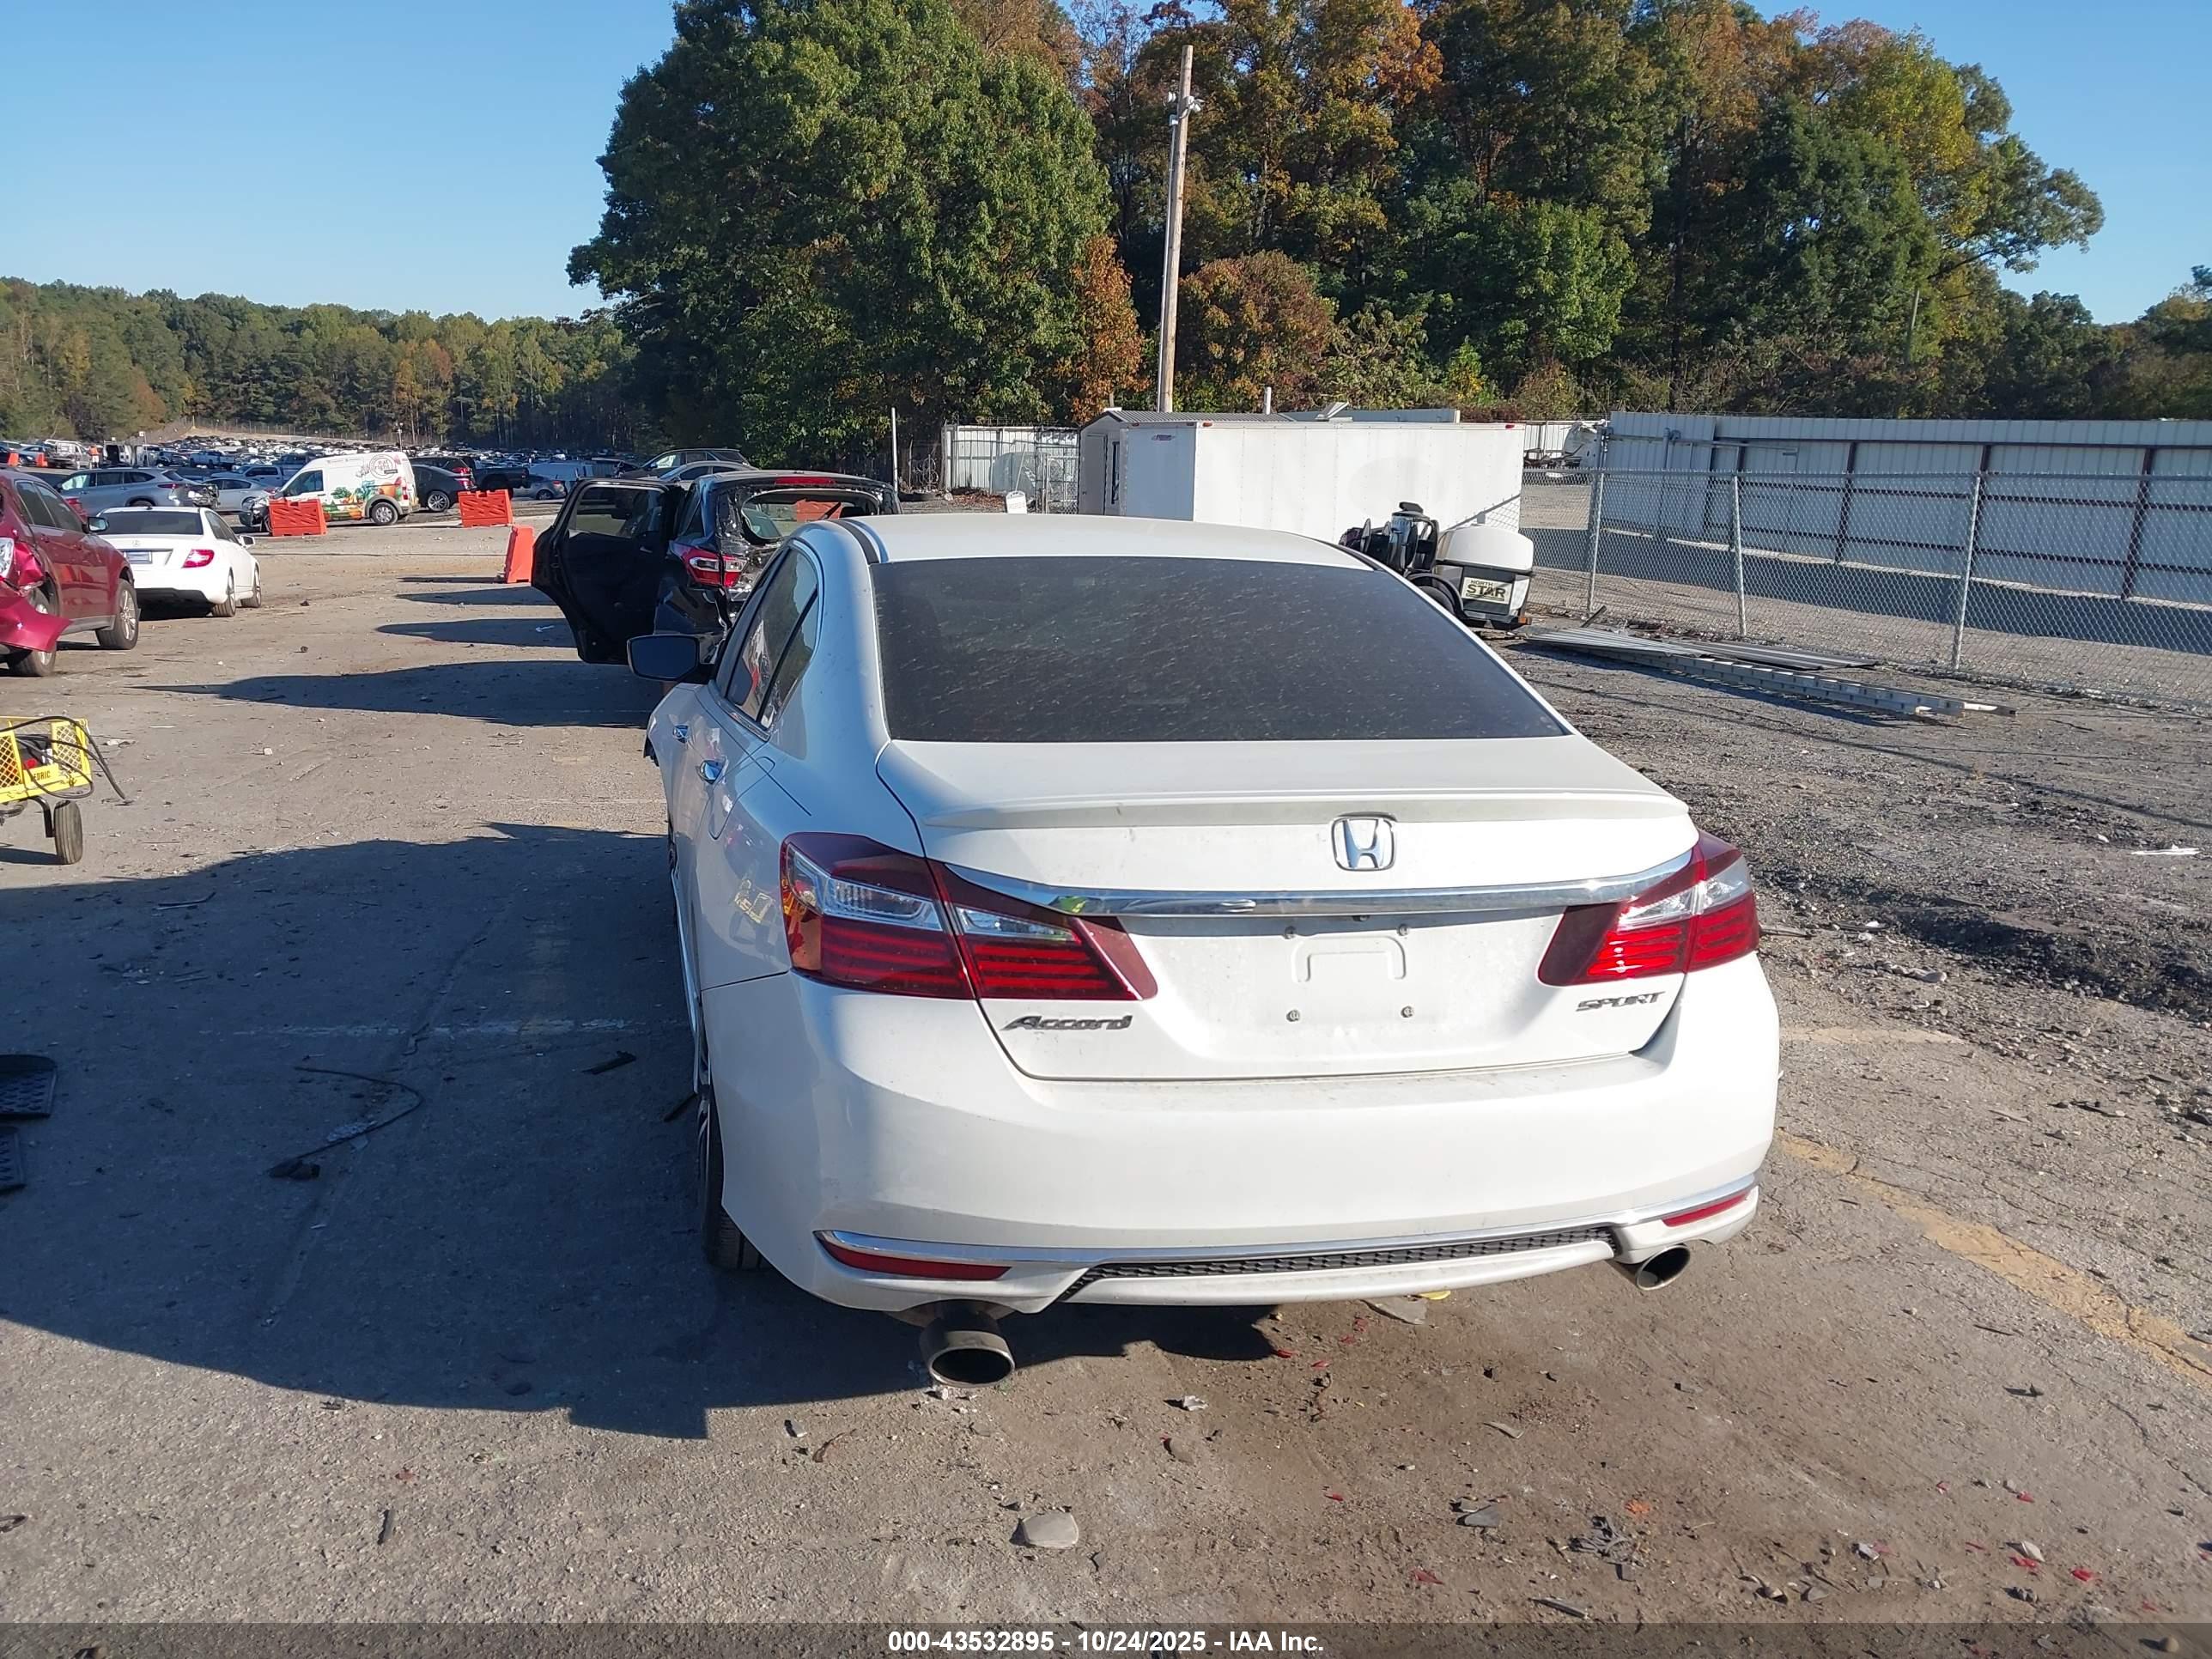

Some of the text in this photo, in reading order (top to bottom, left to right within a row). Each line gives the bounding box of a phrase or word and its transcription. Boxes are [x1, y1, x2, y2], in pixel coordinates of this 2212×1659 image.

[1467, 584, 1506, 598] STAR
[1576, 991, 1665, 1012] SPORT
[1000, 1015, 1133, 1031] Accord
